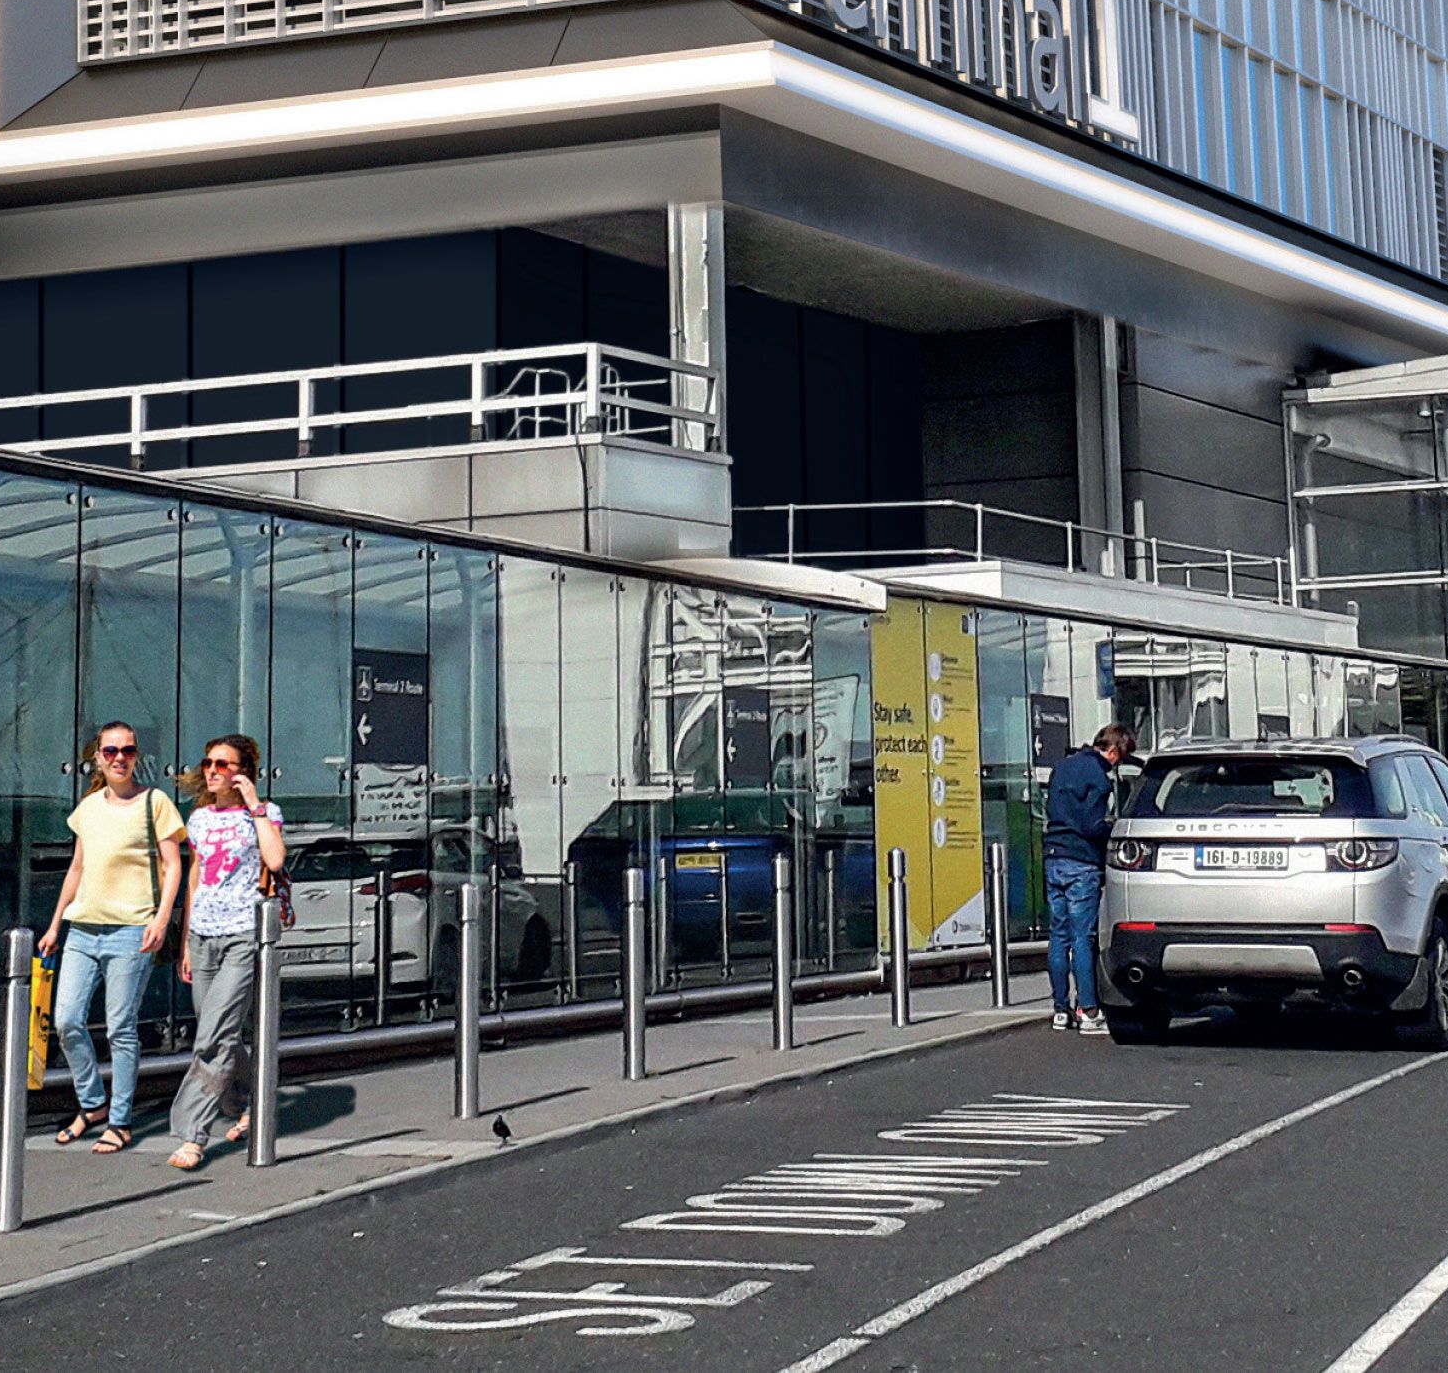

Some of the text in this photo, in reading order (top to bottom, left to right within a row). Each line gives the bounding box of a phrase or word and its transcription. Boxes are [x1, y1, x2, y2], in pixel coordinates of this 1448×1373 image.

[874, 702, 892, 725] Stay
[875, 735, 906, 755] protect
[907, 734, 928, 753] each
[382, 1093, 1191, 1336] SET DOWN ONLY
